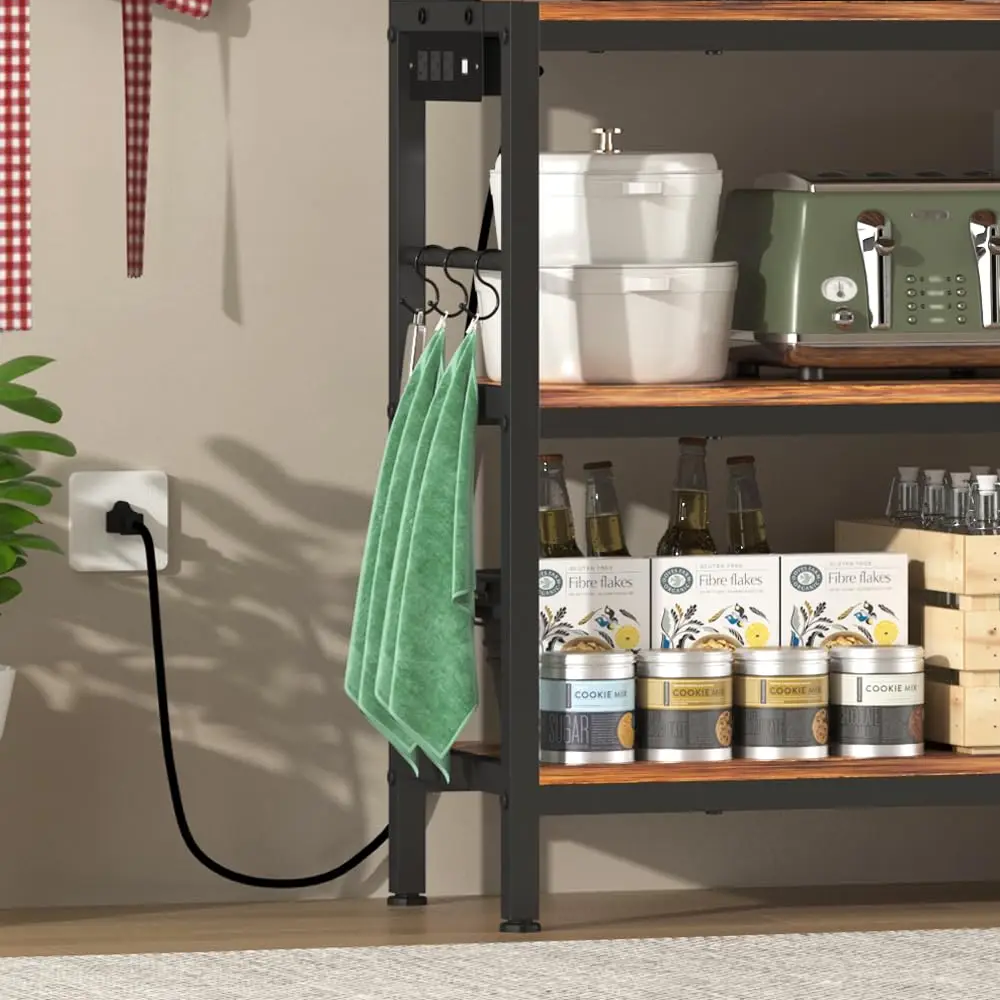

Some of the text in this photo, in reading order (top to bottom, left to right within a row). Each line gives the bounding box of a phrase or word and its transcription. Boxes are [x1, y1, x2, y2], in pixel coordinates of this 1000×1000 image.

[568, 575, 633, 588] Fibre flakes
[699, 572, 763, 587] Fibre flakes
[828, 570, 891, 584] Fibre flakes
[575, 691, 612, 699] COOKIE
[672, 689, 710, 697] COOKIE
[768, 687, 806, 695] COOKIE
[549, 714, 590, 744] SUGAR
